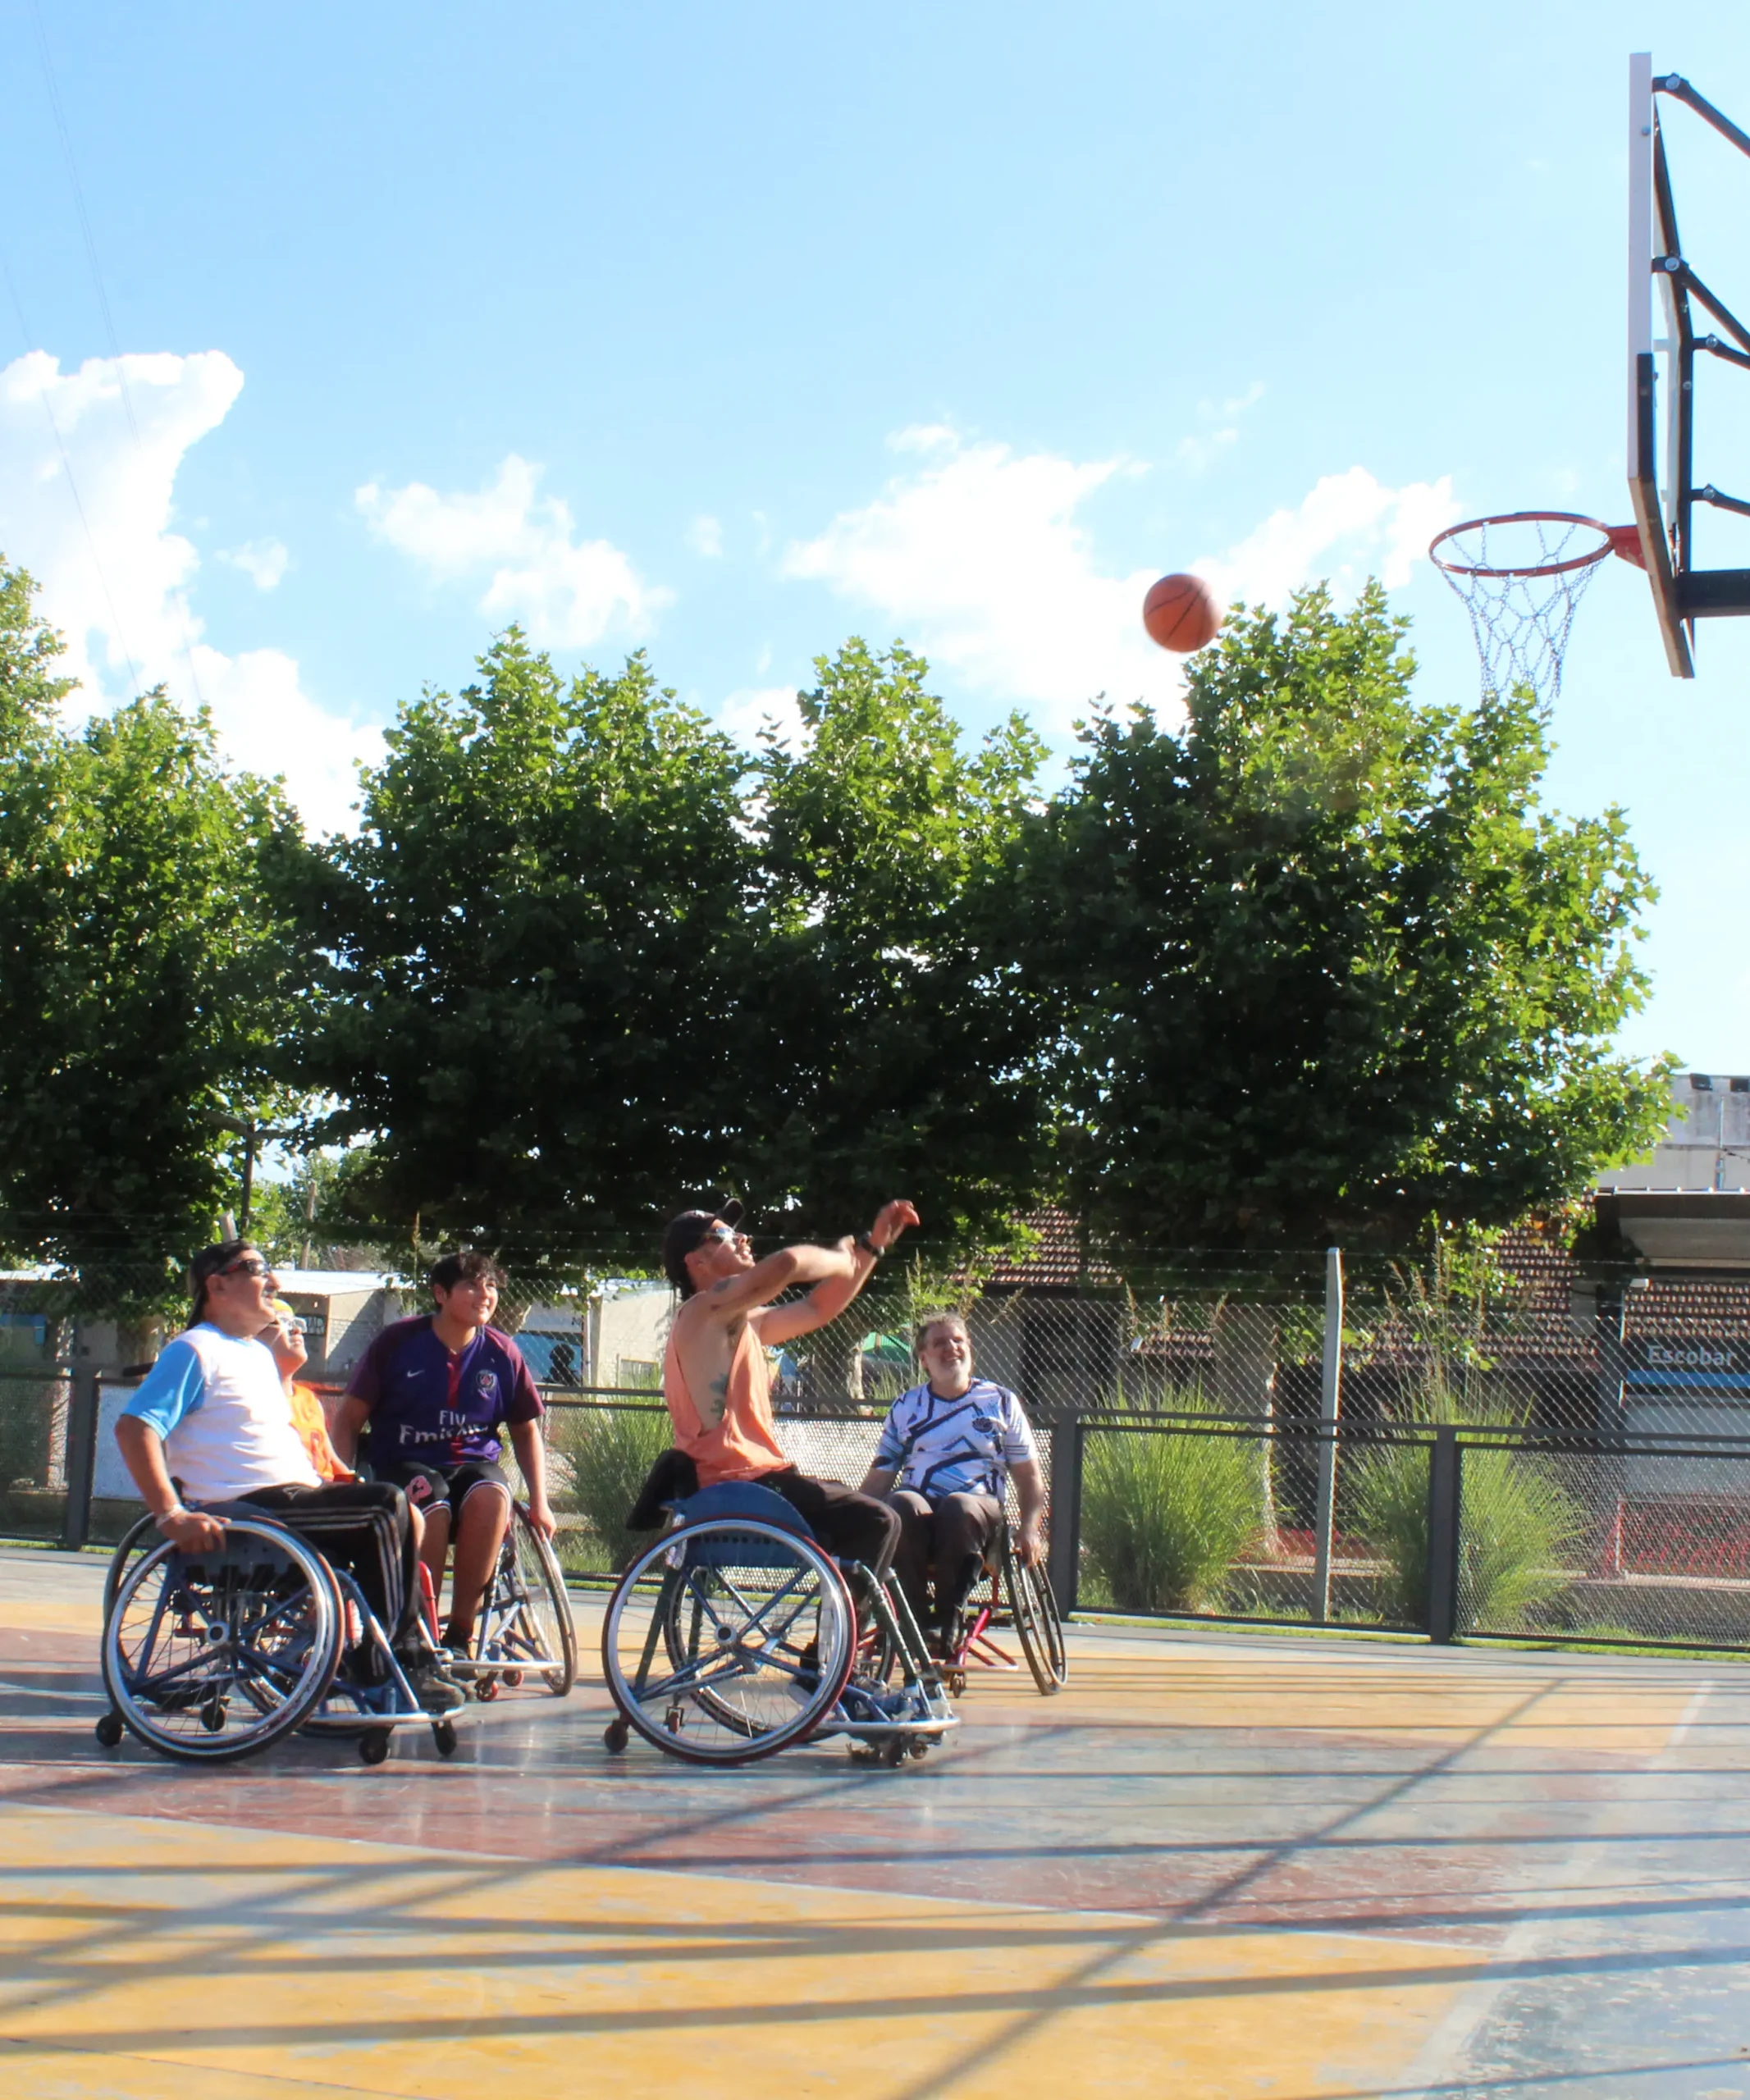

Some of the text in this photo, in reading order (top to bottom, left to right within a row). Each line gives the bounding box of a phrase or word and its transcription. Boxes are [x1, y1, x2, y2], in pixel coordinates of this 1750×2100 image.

[1647, 1345, 1734, 1366] Escobar
[439, 1410, 466, 1428] Fly
[400, 1423, 488, 1444] Emir
